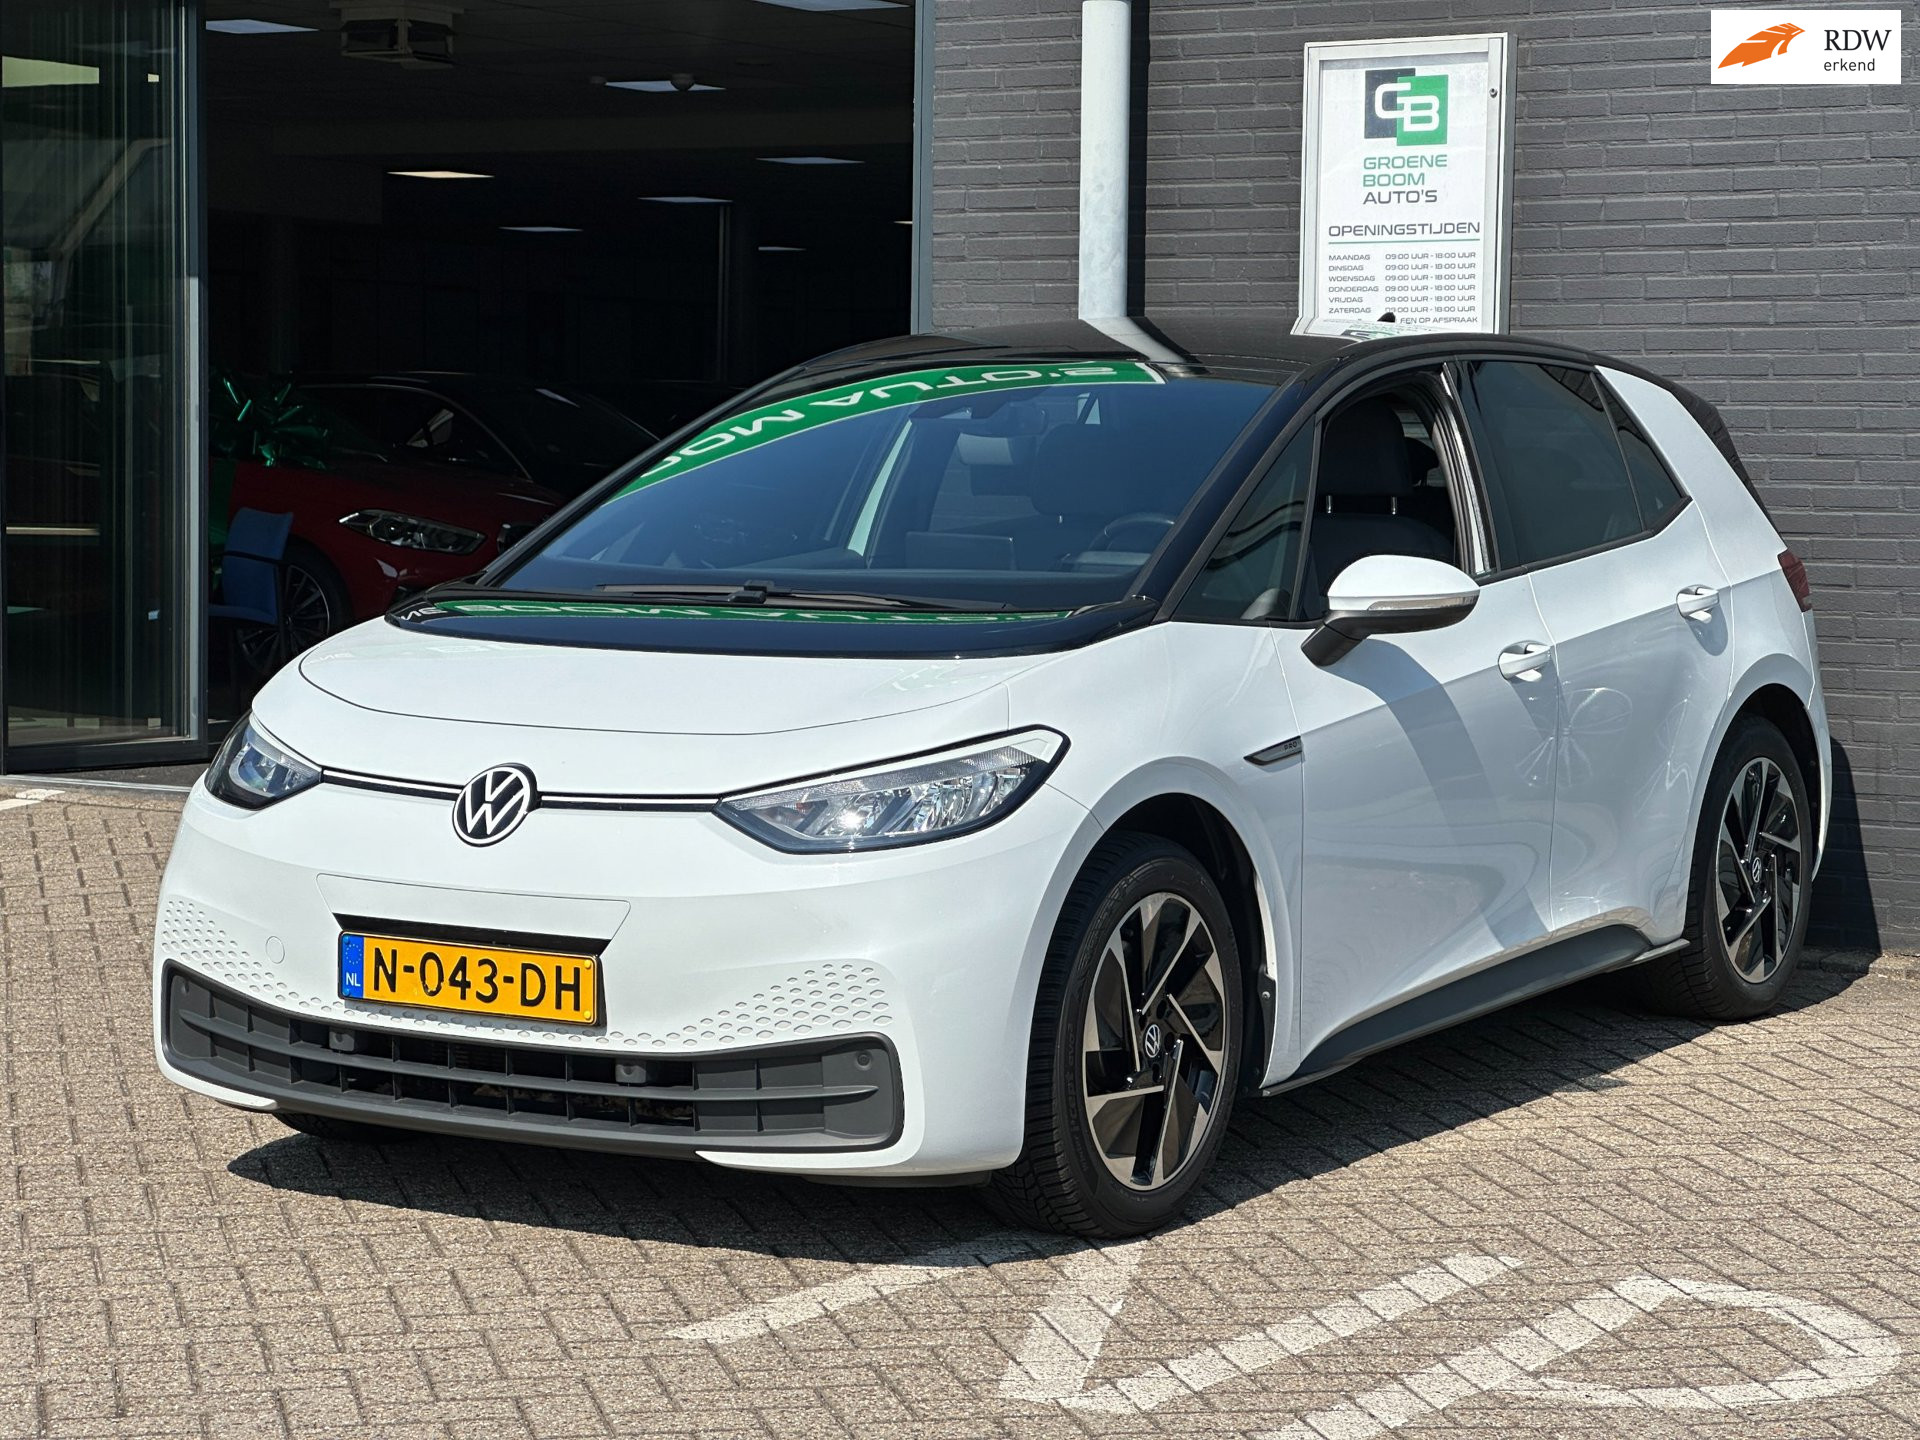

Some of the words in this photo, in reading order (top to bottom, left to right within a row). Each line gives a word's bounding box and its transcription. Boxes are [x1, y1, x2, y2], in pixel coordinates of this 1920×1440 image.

[1363, 154, 1448, 170] GROENE
[1363, 172, 1426, 188] BOOM
[1363, 190, 1438, 205] AUTO'S
[1328, 222, 1481, 237] OPENINGSTIJDEN
[345, 972, 361, 987] NL
[373, 947, 582, 1012] N-043-DH
